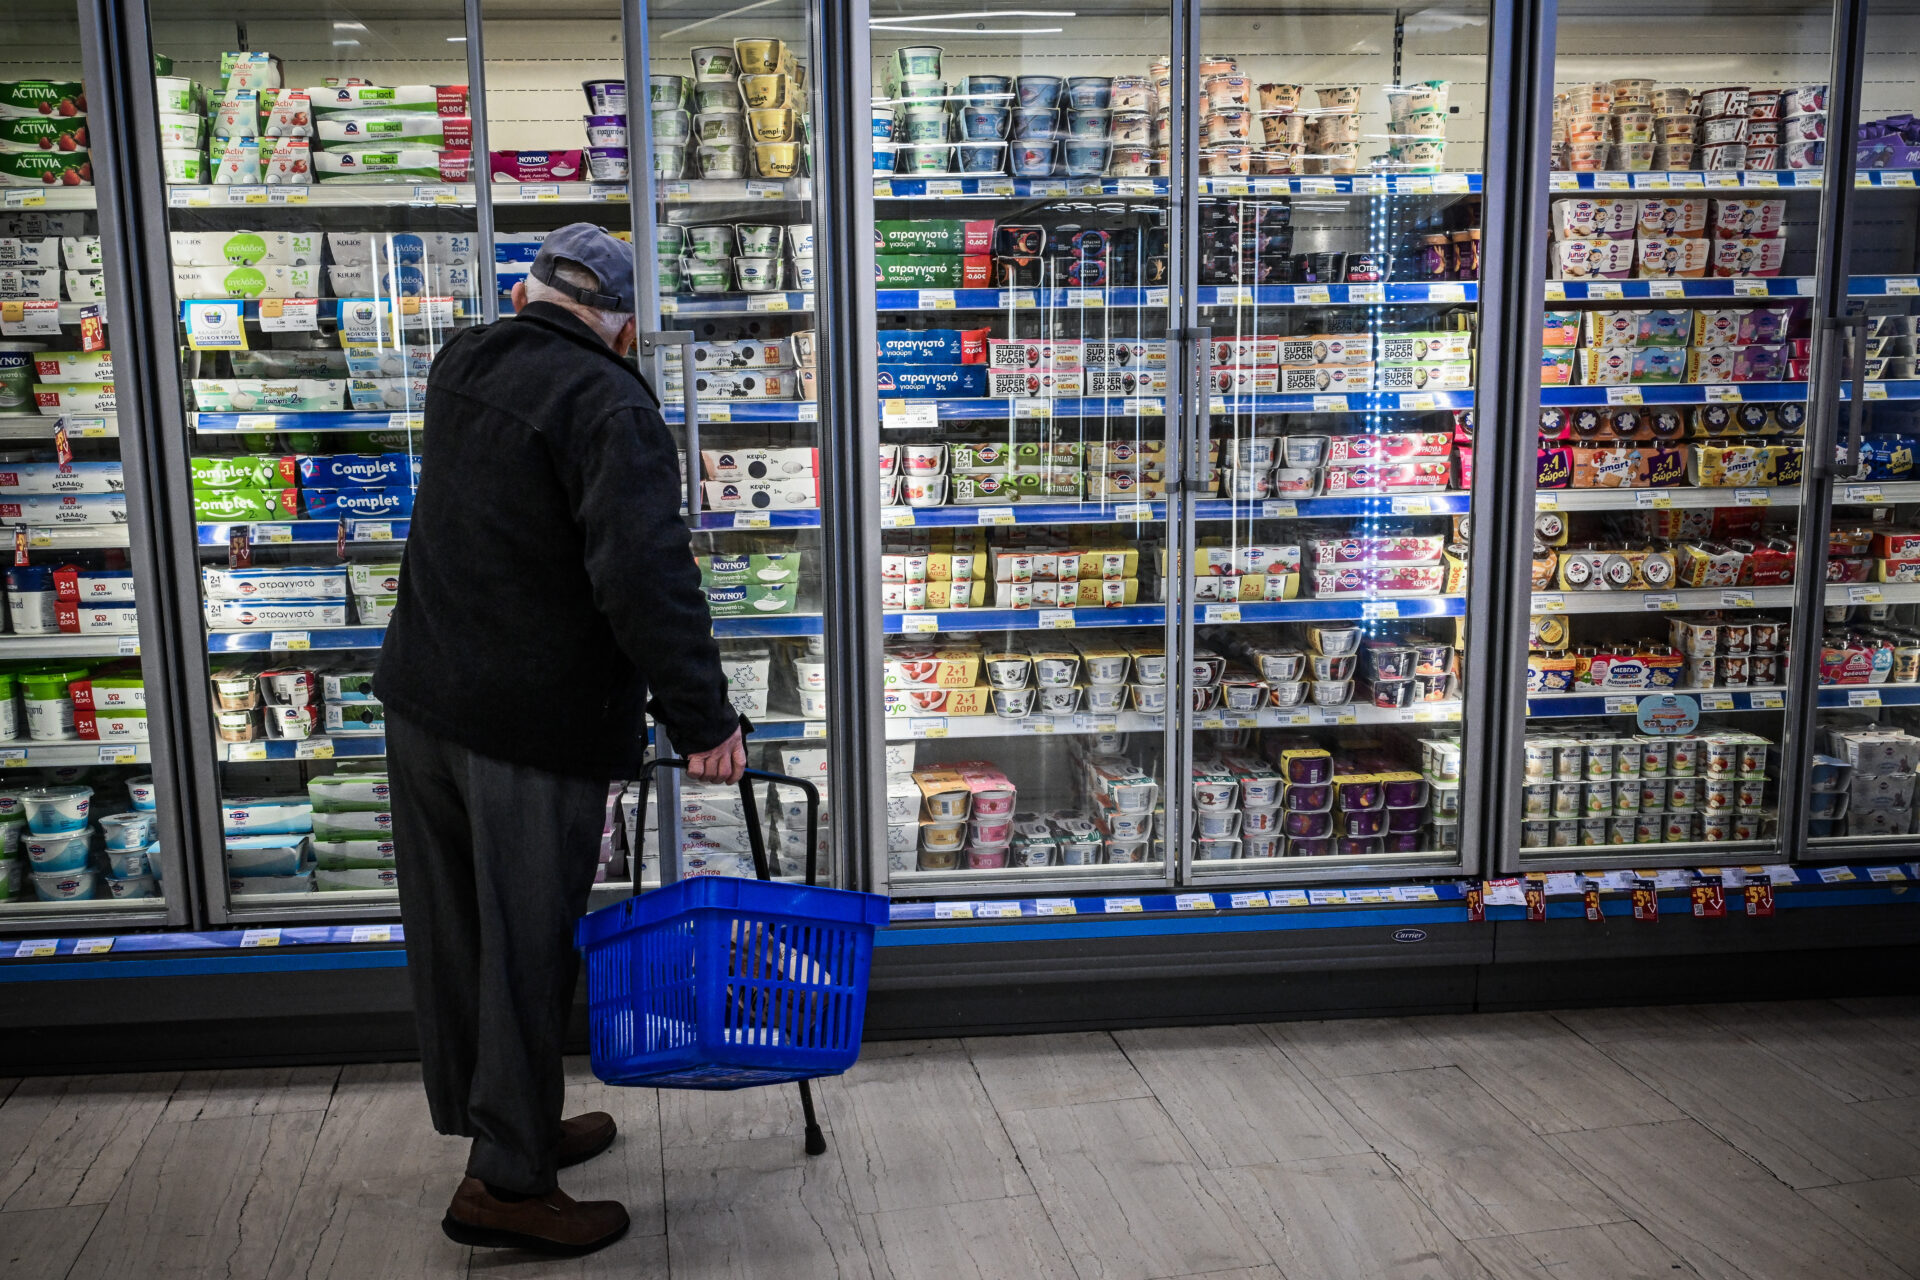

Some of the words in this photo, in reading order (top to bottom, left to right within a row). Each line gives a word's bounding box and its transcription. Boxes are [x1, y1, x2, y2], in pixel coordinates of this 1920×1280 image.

[12, 89, 57, 99] ACTIVIA
[362, 90, 392, 99] freelact
[13, 124, 57, 134] ACTIVIA
[369, 123, 399, 132] freelact
[16, 158, 61, 169] ACTIVIA
[365, 156, 396, 164] freelact
[1574, 211, 1592, 219] junior
[1643, 211, 1661, 219] junior
[1722, 212, 1741, 220] junior
[889, 230, 948, 240] στραγγιστό
[292, 237, 311, 247] 2+1
[452, 237, 469, 247] 2+1
[1568, 252, 1587, 260] junior
[1644, 251, 1662, 259] junior
[1718, 251, 1738, 260] junior
[450, 269, 468, 279] 2+1
[889, 264, 947, 274] στραγγιστό
[1351, 265, 1378, 273] PROTEIN
[290, 270, 309, 280] 2+1
[925, 274, 935, 282] 2%
[886, 338, 945, 348] στραγγιστό
[1284, 346, 1312, 354] SUPER
[900, 372, 958, 383] στραγγιστό
[40, 393, 56, 401] 2+1
[1335, 443, 1347, 454] 2+1
[957, 451, 971, 463] 2+1
[1600, 461, 1629, 473] smart
[1657, 455, 1673, 470] 2+1
[1727, 461, 1757, 472] smart
[192, 465, 252, 481] Complet
[332, 461, 397, 478] Complet
[1333, 473, 1346, 484] 2+1
[1539, 467, 1568, 483] δώρο!
[1652, 467, 1681, 483] δώρο!
[959, 481, 973, 493] 2+1
[336, 494, 399, 510] Complet
[1322, 547, 1334, 558] 2+1
[930, 563, 946, 571] 2+1
[1082, 562, 1099, 570] 2+1
[60, 581, 74, 589] 2+1
[259, 580, 315, 589] στραγγιστό
[1321, 577, 1334, 587] 2+1
[929, 591, 945, 599] 2+1
[1082, 586, 1099, 594] 2+1
[259, 610, 314, 619] στραγγιστό
[947, 665, 966, 677] 2+1
[944, 676, 968, 684] ΔΩΡΟ
[75, 690, 89, 698] 2+1
[957, 693, 976, 705] 2+1
[954, 705, 978, 713] ΔΩΡΟ
[1633, 890, 1650, 907] -5%
[1692, 887, 1715, 904] -5%
[1745, 886, 1766, 902] -5%
[1395, 931, 1422, 939] Carrier
